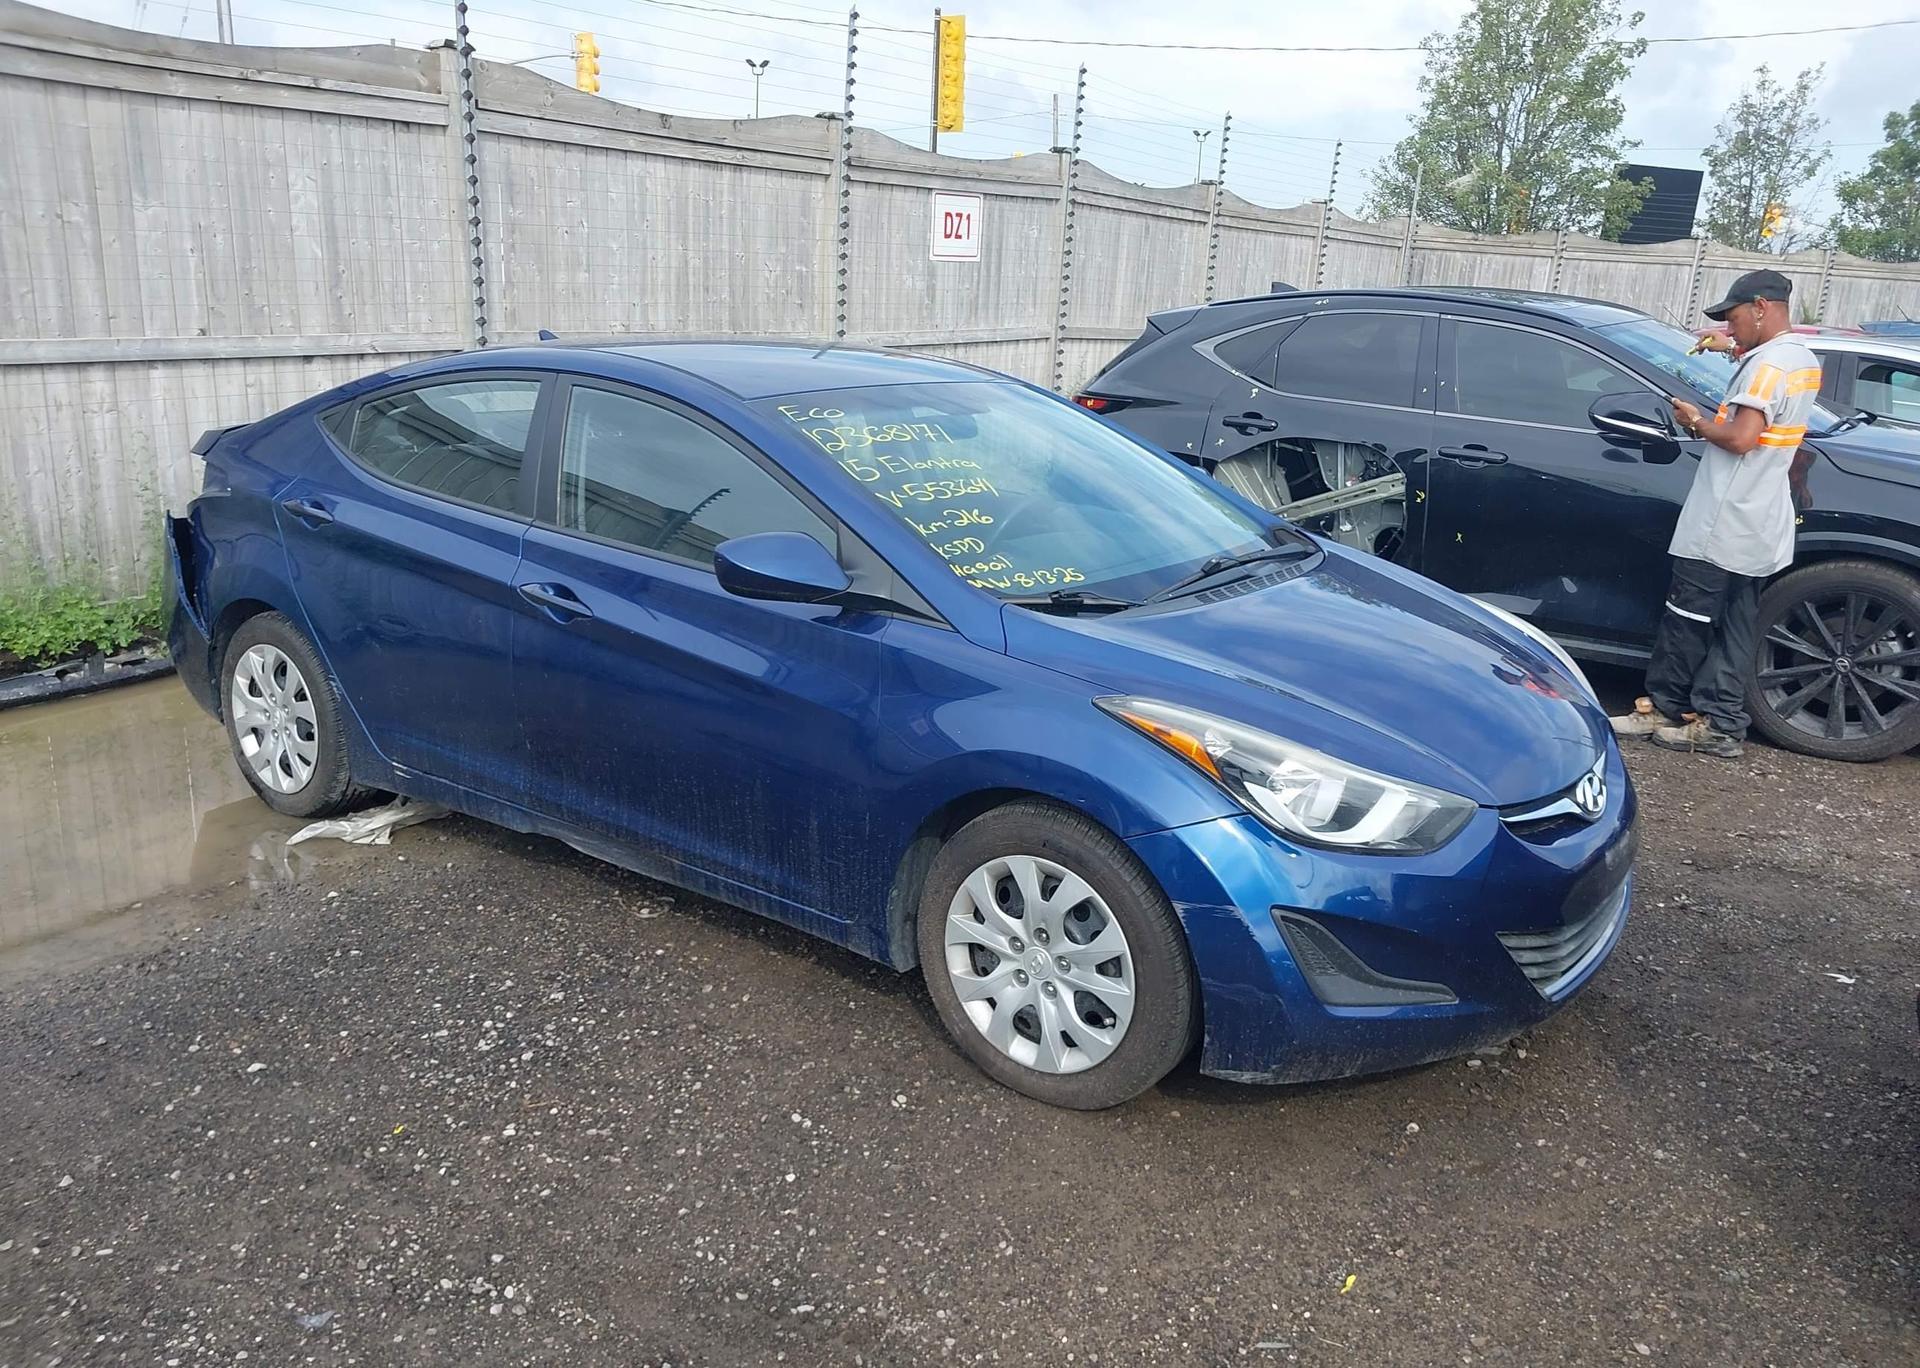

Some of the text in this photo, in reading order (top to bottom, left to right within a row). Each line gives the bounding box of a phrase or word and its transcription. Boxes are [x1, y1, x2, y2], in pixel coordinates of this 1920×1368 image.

[944, 211, 971, 240] DZ1
[801, 423, 954, 455] 12368171
[838, 455, 982, 482] 15 Elantra
